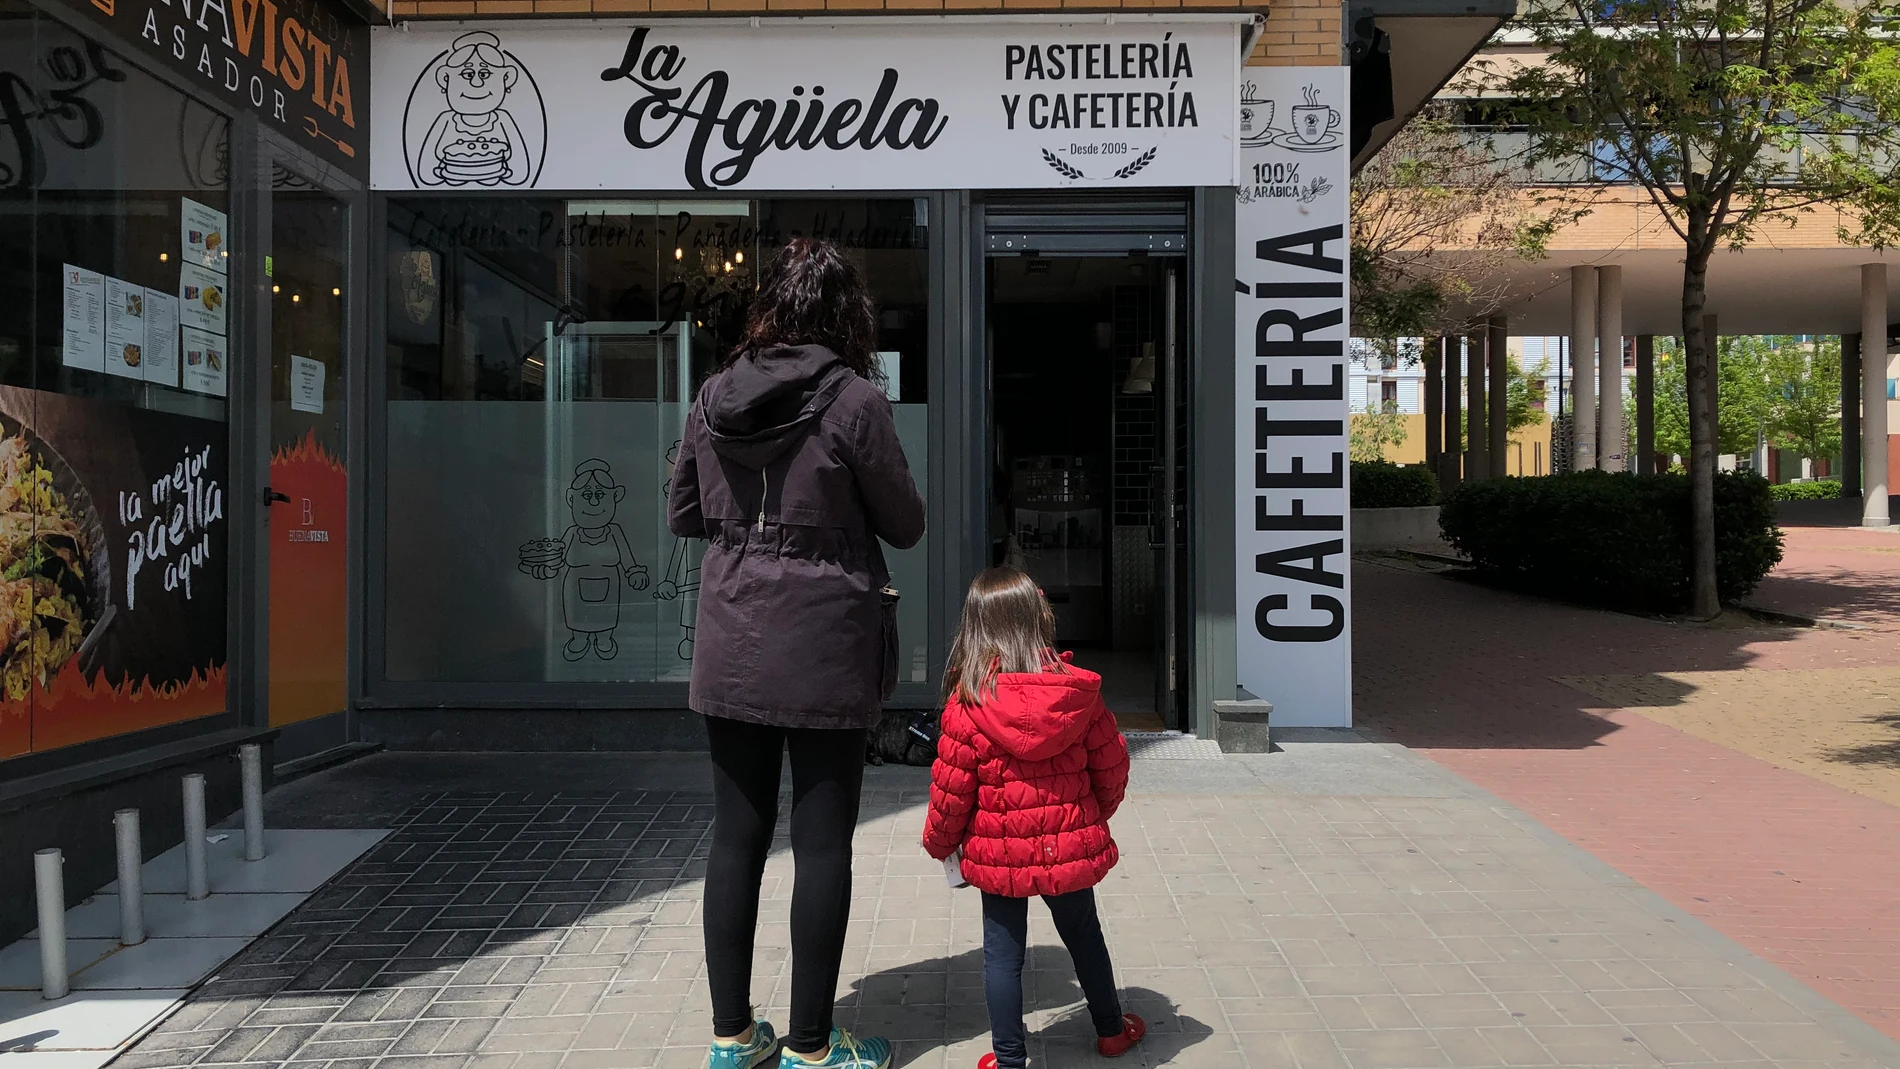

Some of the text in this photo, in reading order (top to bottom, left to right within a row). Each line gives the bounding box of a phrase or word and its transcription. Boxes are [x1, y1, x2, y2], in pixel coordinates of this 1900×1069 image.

[142, 7, 286, 123] ASADOR
[601, 28, 687, 83] La
[1005, 32, 1193, 81] PASTELERÍA
[623, 68, 949, 190] Agüela
[1001, 81, 1199, 130] Y CAFETERÍA
[1070, 141, 1128, 155] Desde 2009
[1252, 162, 1300, 184] 100%
[1253, 181, 1300, 198] ARÁBICA
[1236, 223, 1345, 642] CAFETERÍA
[119, 444, 211, 527] la mejor
[127, 477, 223, 611] paella
